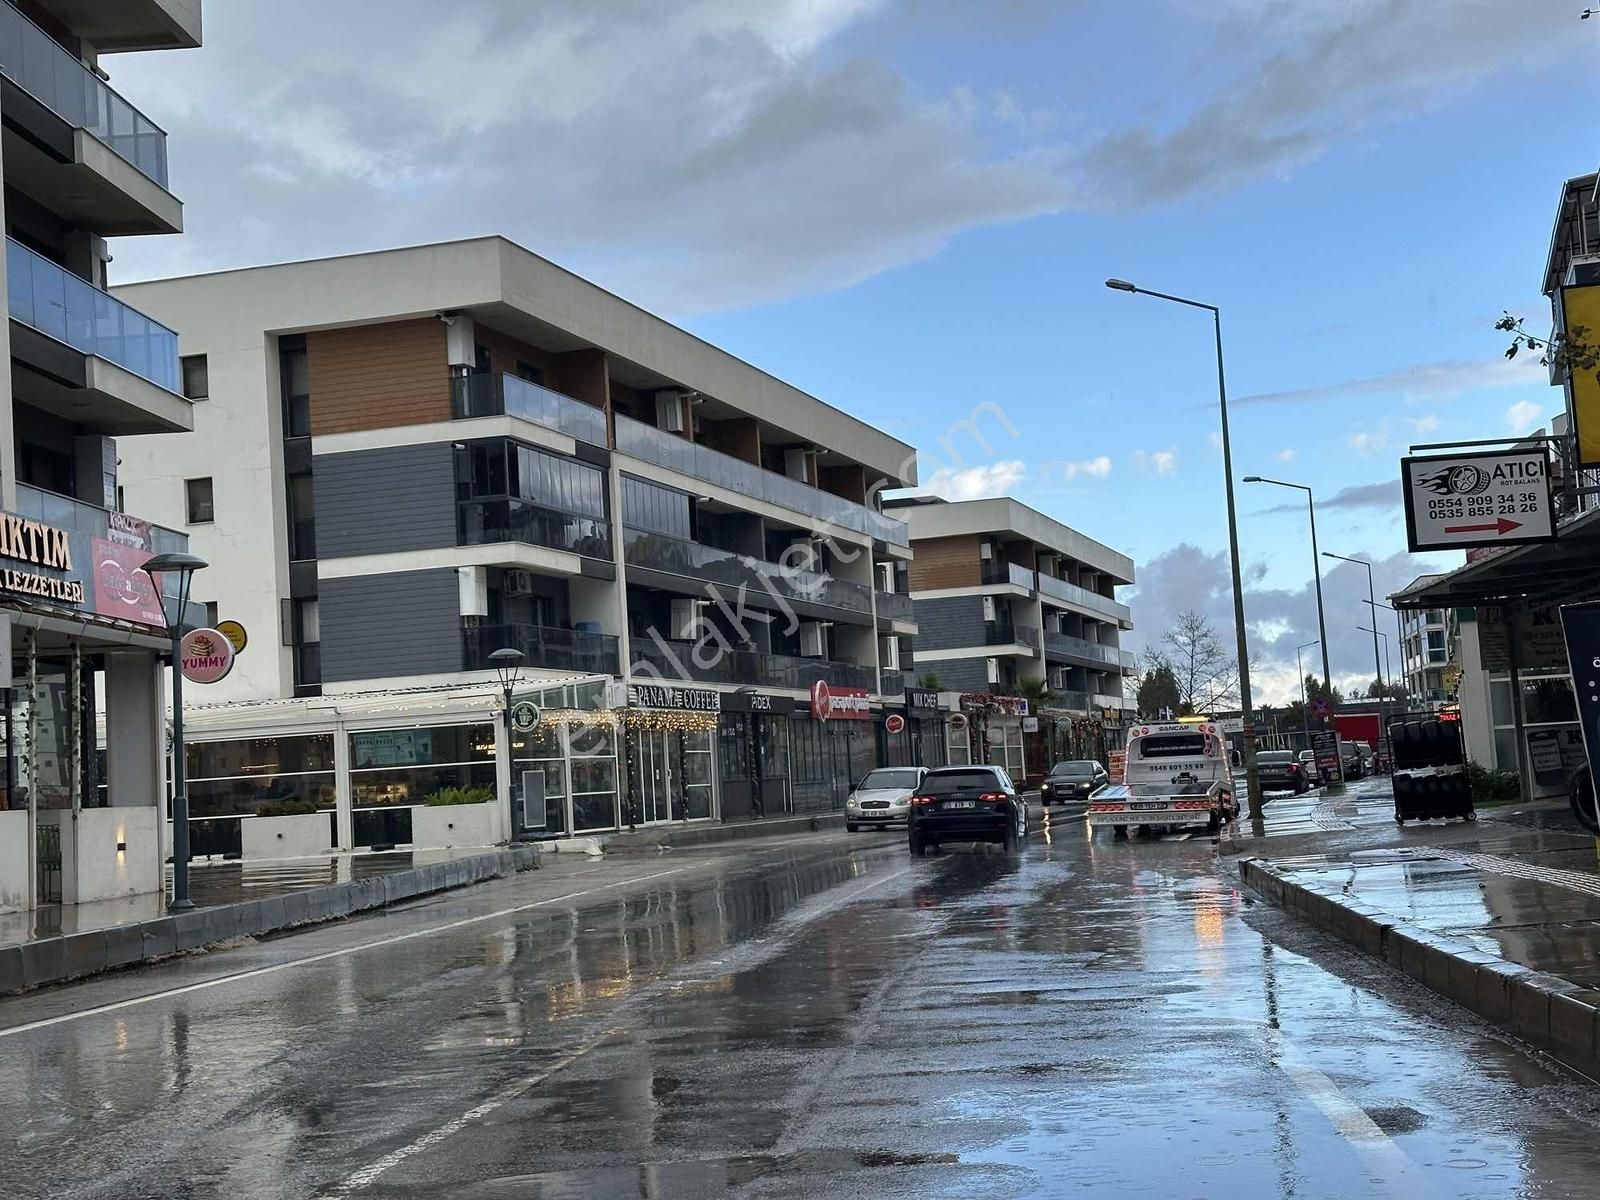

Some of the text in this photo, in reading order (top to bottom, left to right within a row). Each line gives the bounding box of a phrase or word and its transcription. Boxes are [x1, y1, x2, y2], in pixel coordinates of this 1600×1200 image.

[1492, 460, 1544, 480] ATICI
[1428, 492, 1537, 510] 0554 909 34 36
[1429, 503, 1538, 520] 0535 855 28 26
[182, 656, 226, 669] YUMMY
[637, 685, 716, 709] PANAMA COFFEE
